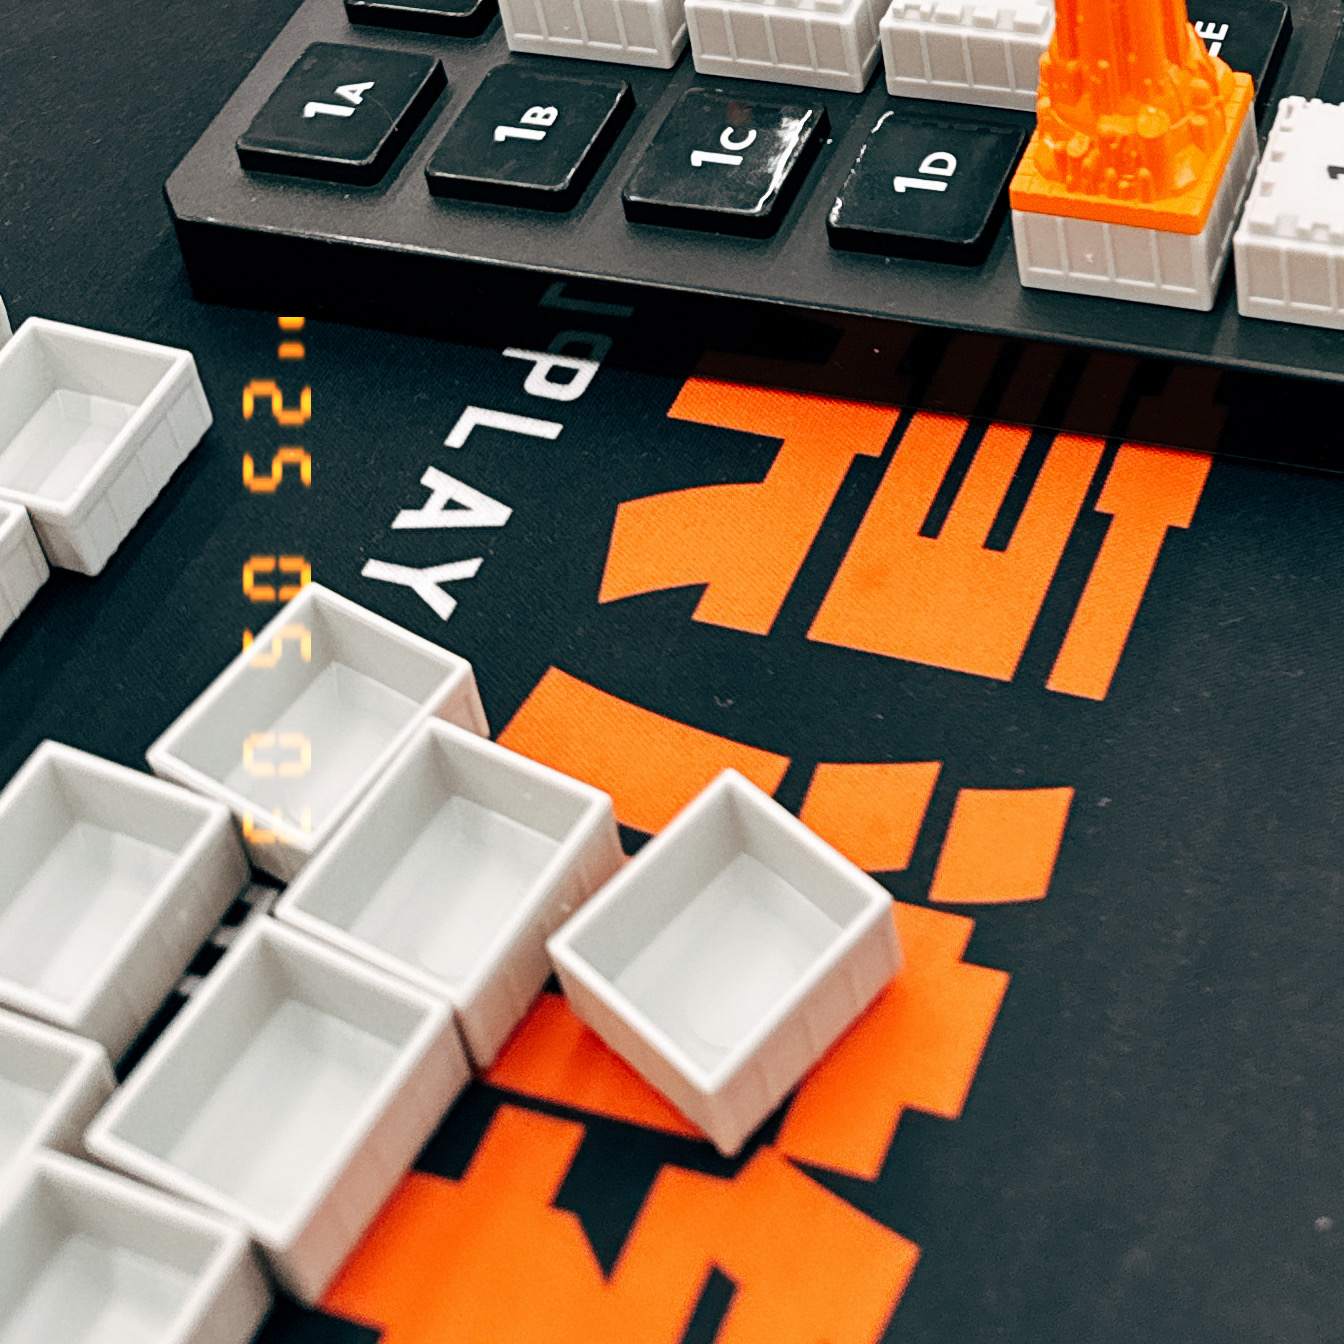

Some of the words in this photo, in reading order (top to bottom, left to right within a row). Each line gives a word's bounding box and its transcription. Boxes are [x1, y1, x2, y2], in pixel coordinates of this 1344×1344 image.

[302, 81, 375, 117] 1A
[493, 105, 559, 143] 1B
[690, 126, 758, 167] 1C
[892, 151, 958, 193] 1D
[361, 345, 600, 621] PLAY
